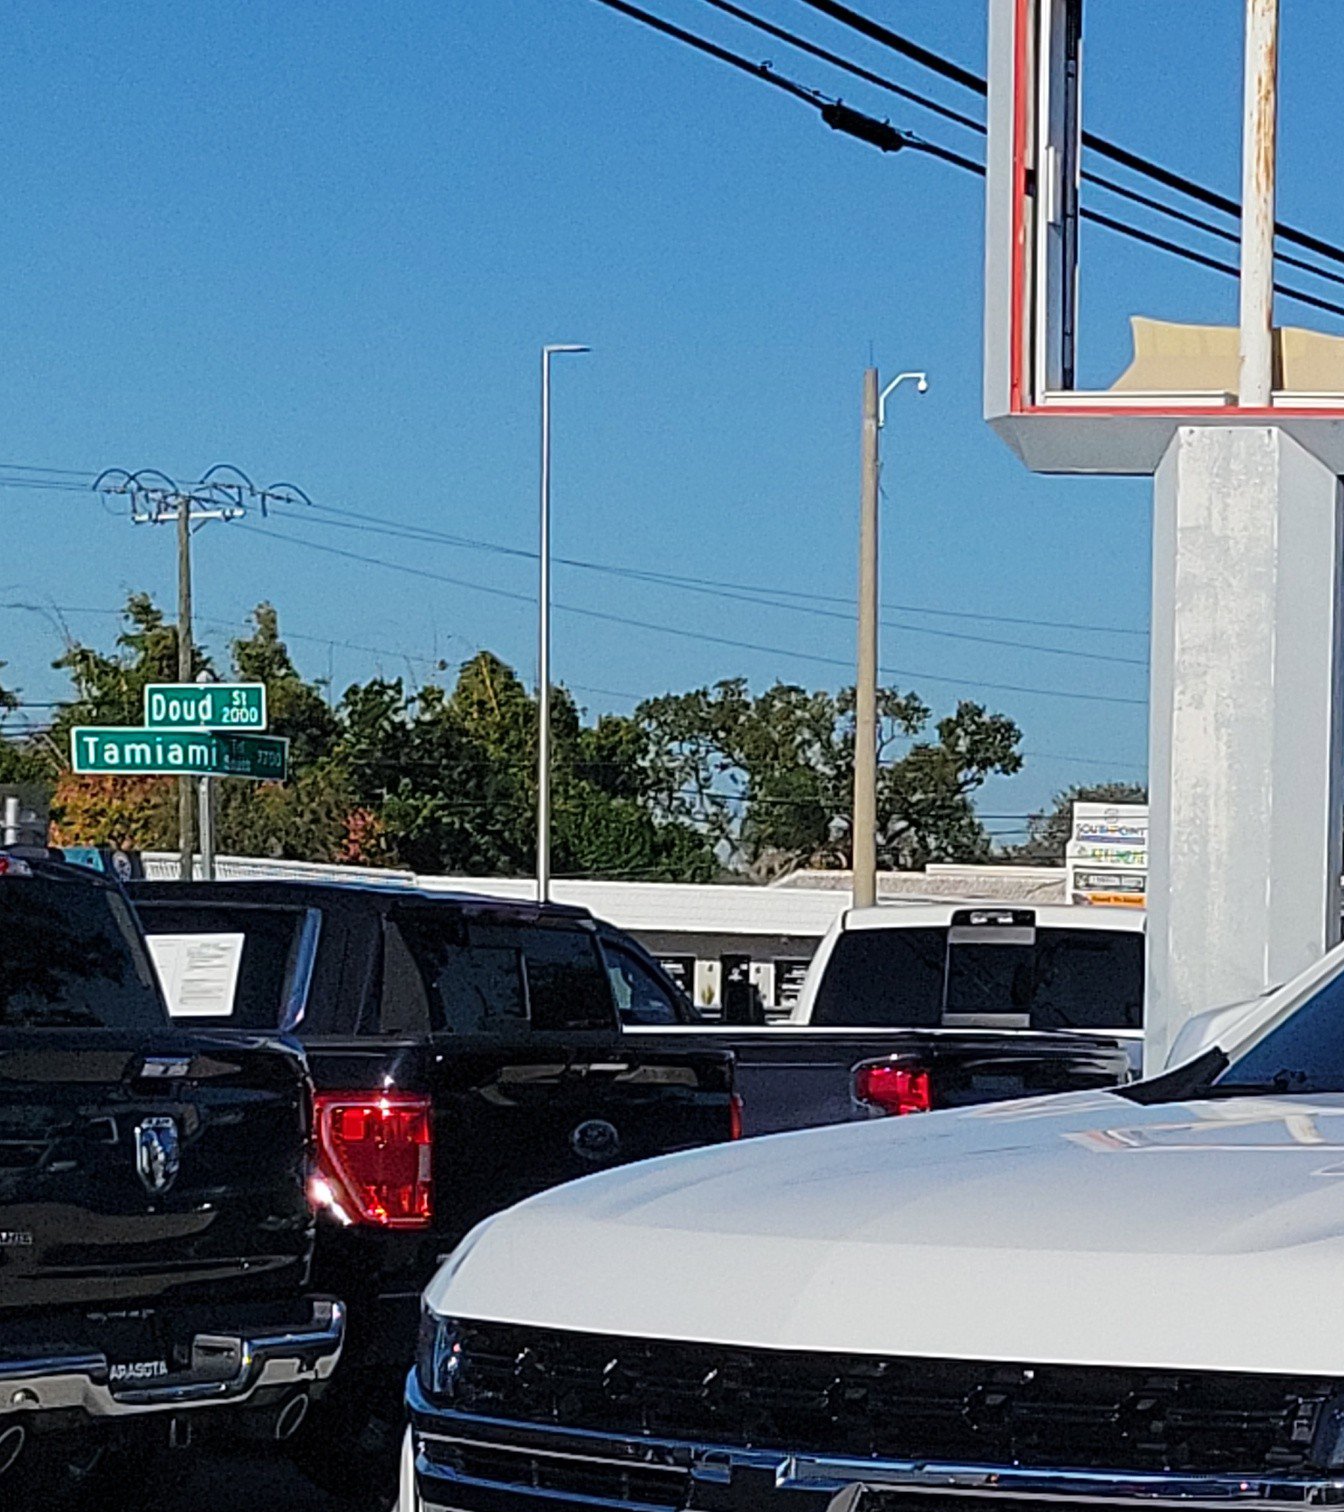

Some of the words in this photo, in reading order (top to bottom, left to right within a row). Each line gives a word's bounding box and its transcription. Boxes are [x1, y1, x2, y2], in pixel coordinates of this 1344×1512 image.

[151, 693, 212, 722] Doud
[232, 690, 248, 706] St
[221, 707, 259, 723] 2000
[82, 736, 218, 767] Tamiami
